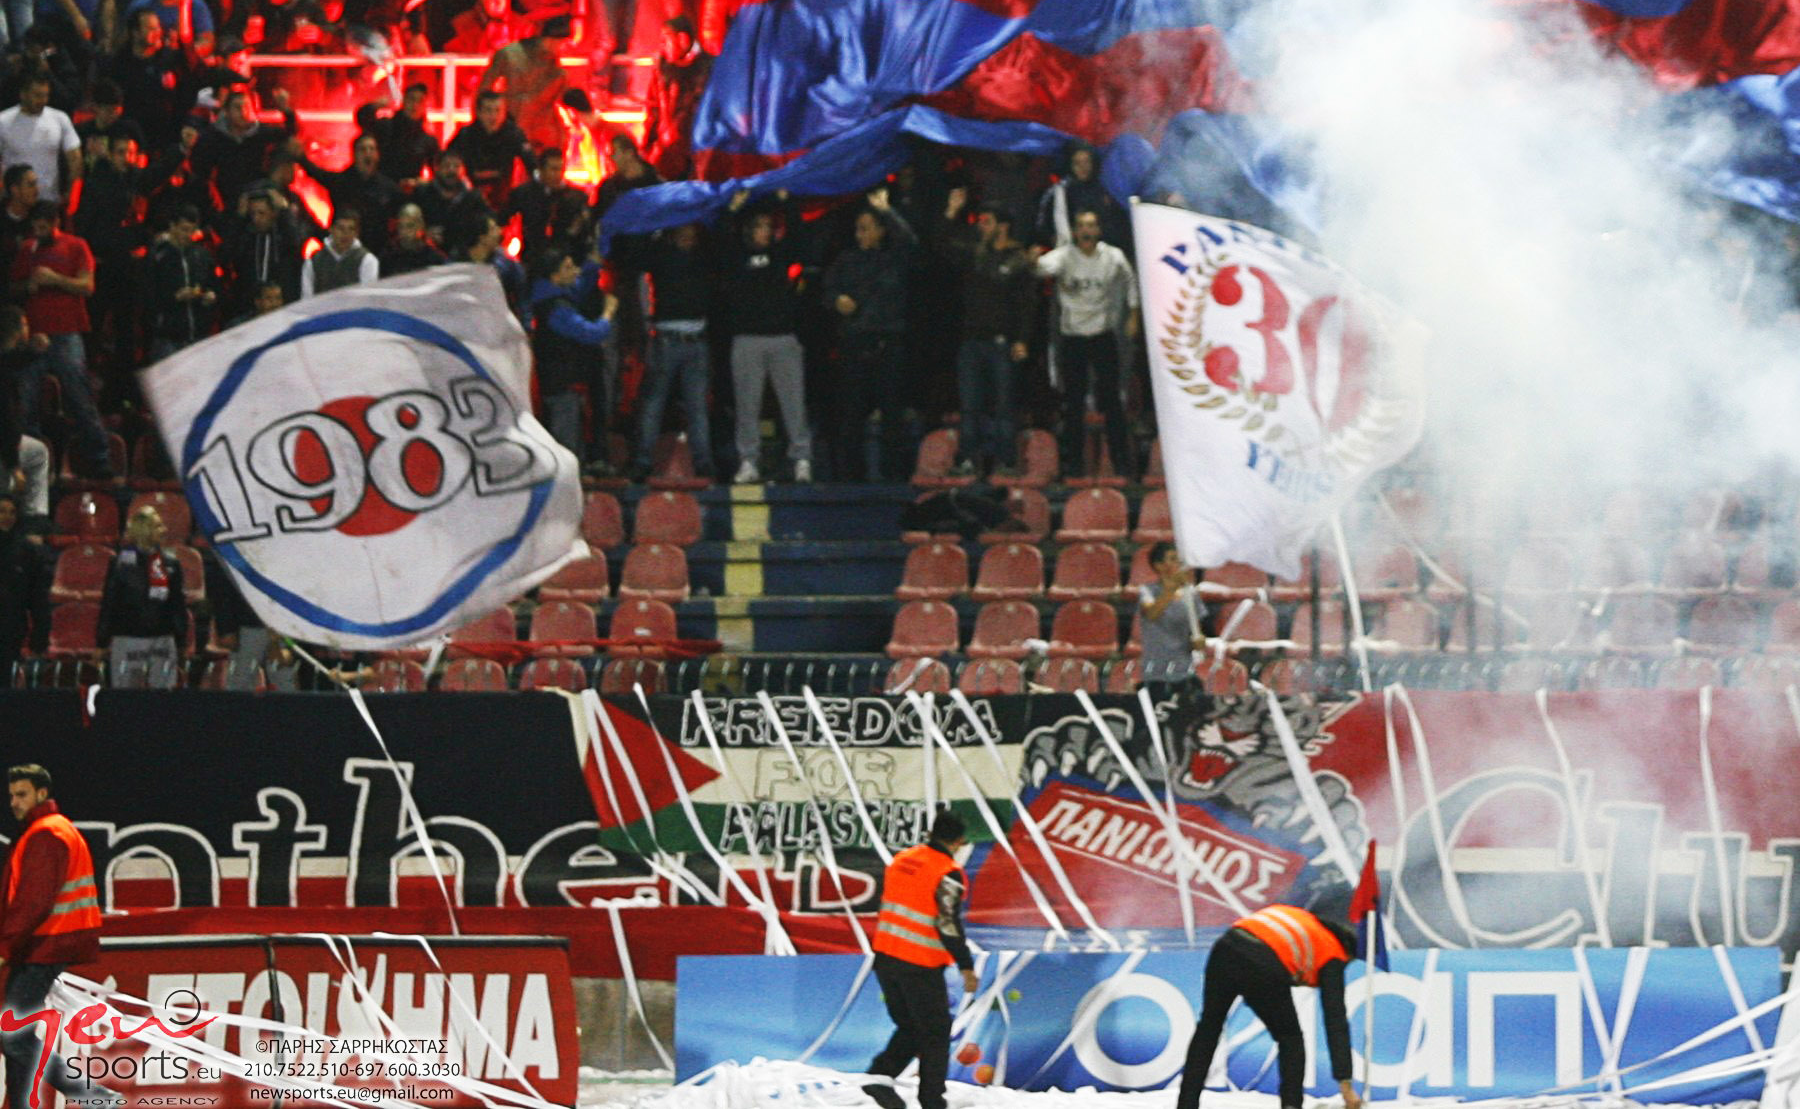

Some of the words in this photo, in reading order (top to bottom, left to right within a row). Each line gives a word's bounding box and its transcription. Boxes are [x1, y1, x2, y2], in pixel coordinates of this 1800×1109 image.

[1204, 264, 1371, 432] 30
[187, 375, 559, 544] 1983
[680, 695, 1002, 746] FREEDOM
[754, 748, 897, 801] FOR
[719, 800, 951, 852] PALESTIN
